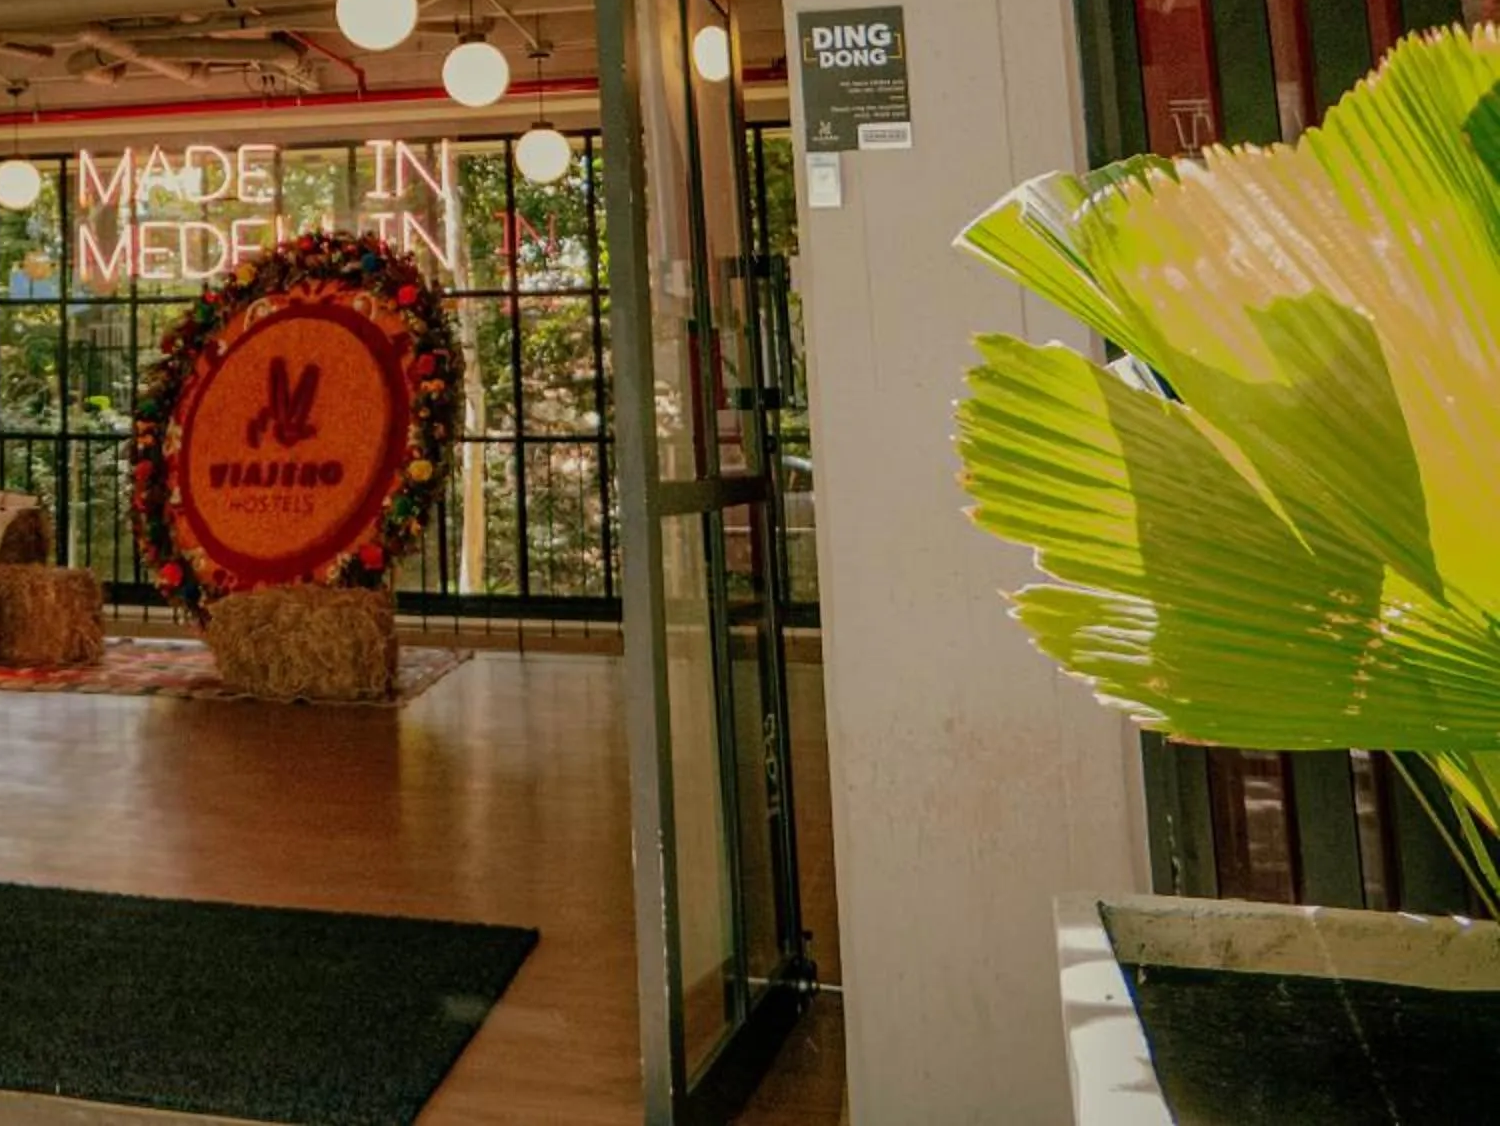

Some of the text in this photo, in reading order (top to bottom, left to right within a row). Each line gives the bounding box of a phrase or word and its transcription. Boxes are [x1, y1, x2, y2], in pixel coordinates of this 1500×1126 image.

[812, 23, 891, 50] DING
[819, 48, 887, 68] DONG
[79, 138, 448, 206] MADE IN
